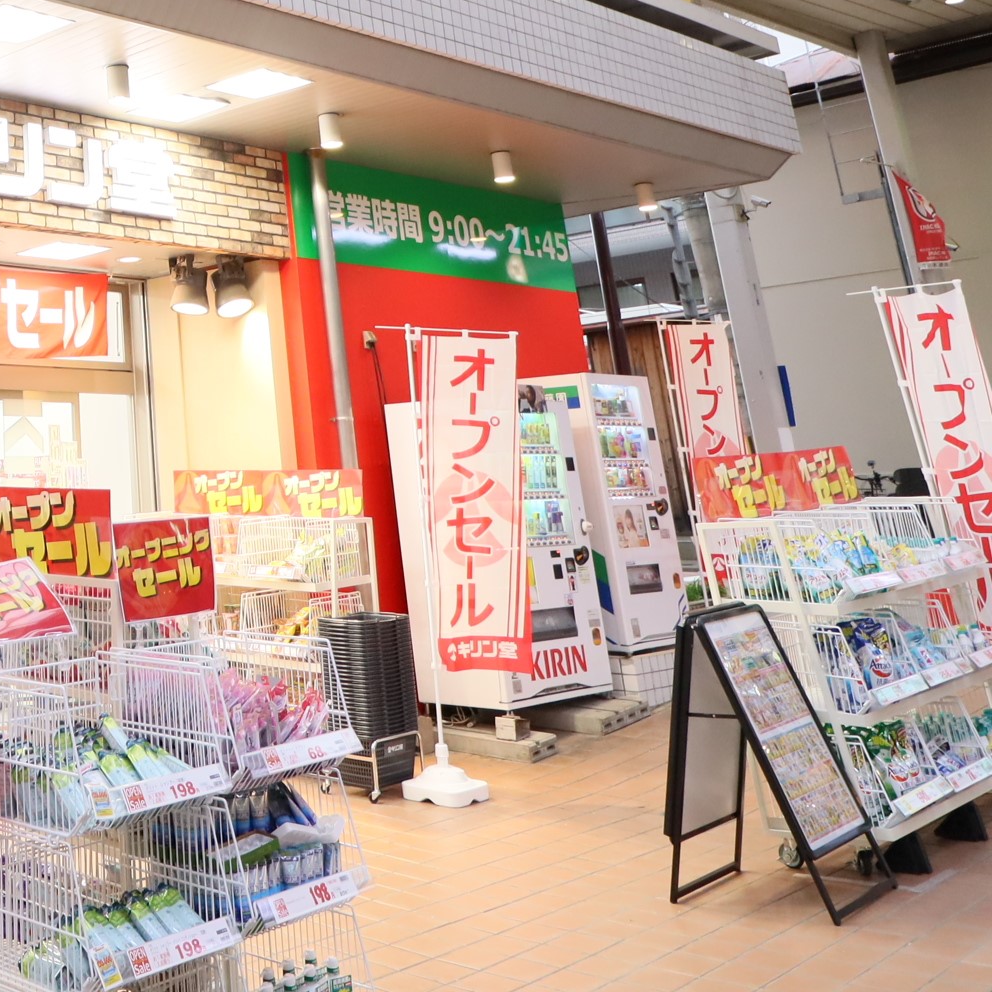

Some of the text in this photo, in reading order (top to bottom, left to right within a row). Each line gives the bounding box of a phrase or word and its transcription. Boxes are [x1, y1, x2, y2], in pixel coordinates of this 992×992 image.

[328, 190, 424, 244] 営業時間
[194, 471, 244, 494] オープン
[284, 471, 340, 496] オープン
[714, 455, 764, 491] オープン
[797, 448, 836, 484] オープン
[207, 485, 263, 515] セール
[298, 487, 362, 518] セール
[445, 348, 501, 628] オープンセール
[731, 473, 786, 519] セール
[811, 466, 859, 505] セール
[10, 521, 113, 576] セール
[116, 529, 211, 569] オープニング
[132, 557, 202, 598] セール
[457, 640, 518, 659] キリン堂
[531, 644, 588, 682] KIRIN
[126, 785, 142, 798] OPEN
[129, 799, 147, 810] Sale
[129, 946, 147, 961] OPEN
[133, 962, 151, 975] Sale
